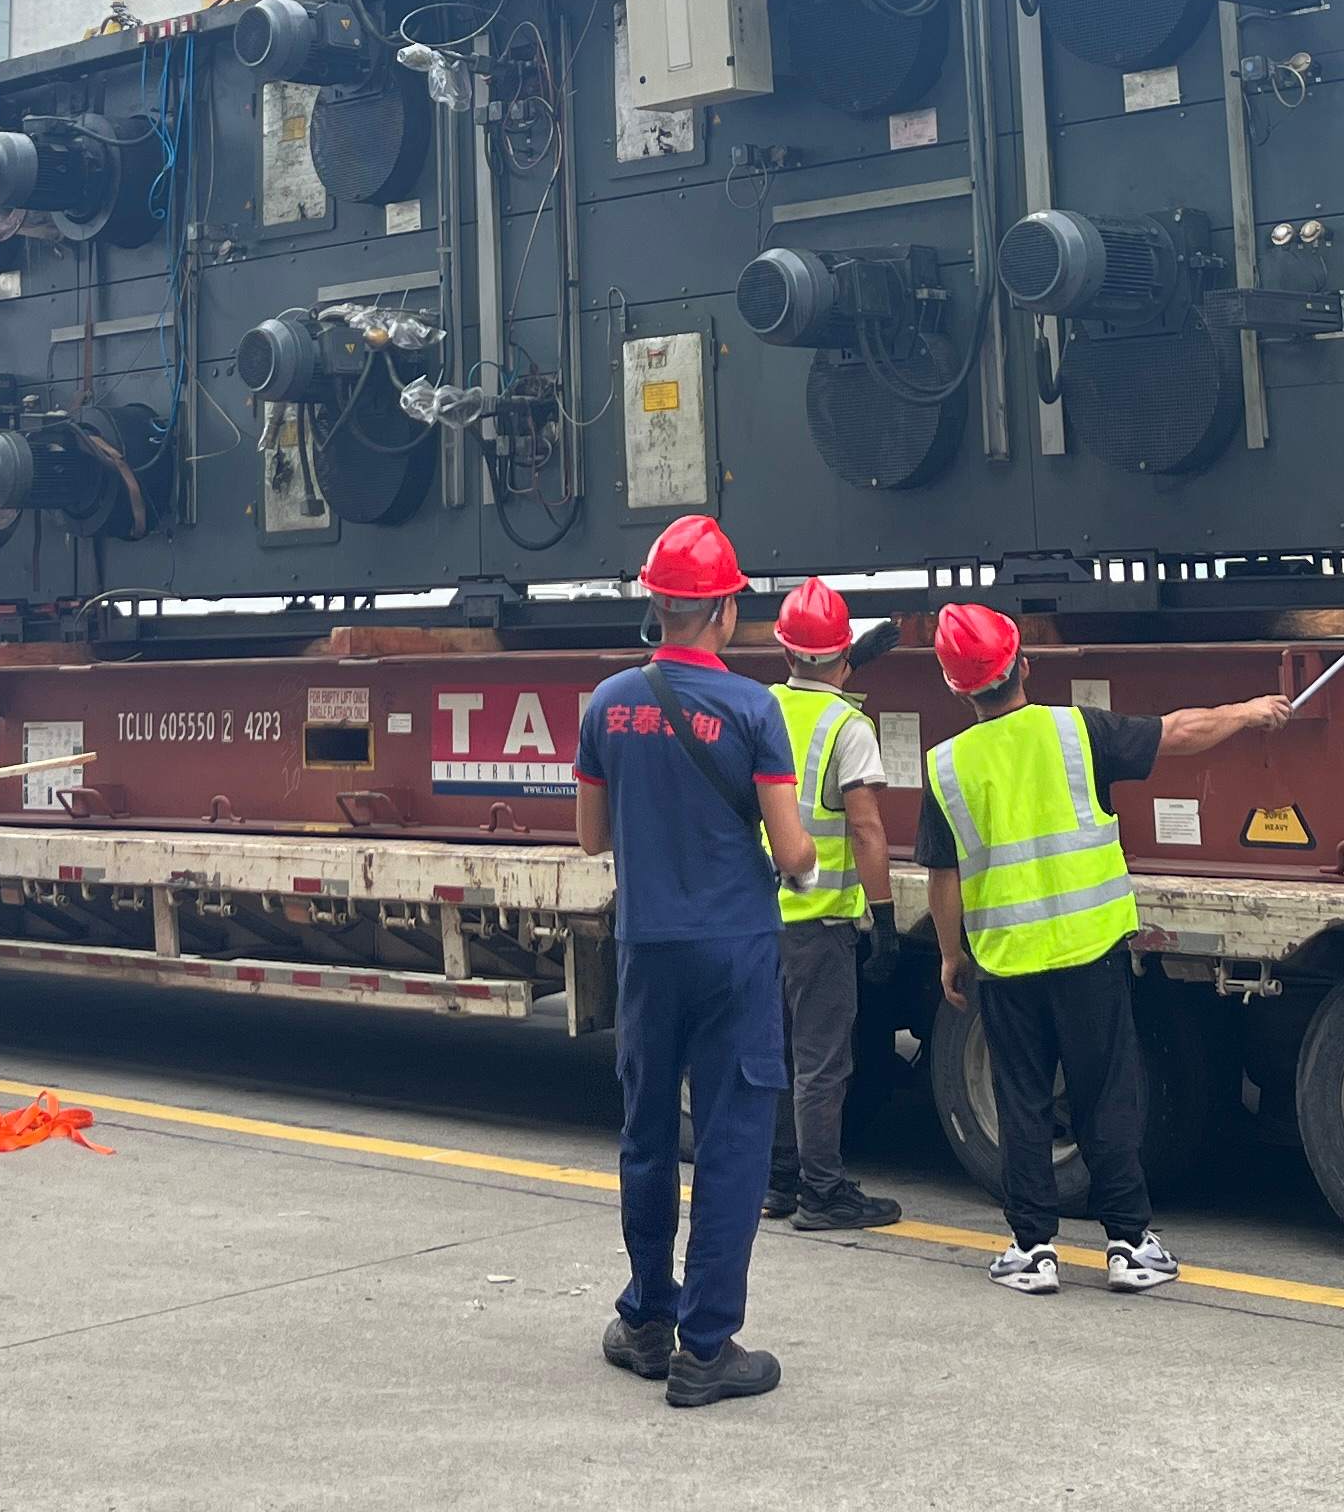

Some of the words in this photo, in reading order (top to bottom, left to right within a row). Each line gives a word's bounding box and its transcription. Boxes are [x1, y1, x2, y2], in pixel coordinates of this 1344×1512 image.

[118, 712, 153, 741] TCLU
[159, 712, 215, 741] 605550
[223, 711, 233, 741] 2
[244, 711, 281, 741] 42P3
[607, 704, 722, 744] 安泰卸
[1264, 812, 1289, 820] SUPER
[1264, 823, 1289, 831] HEAVY
